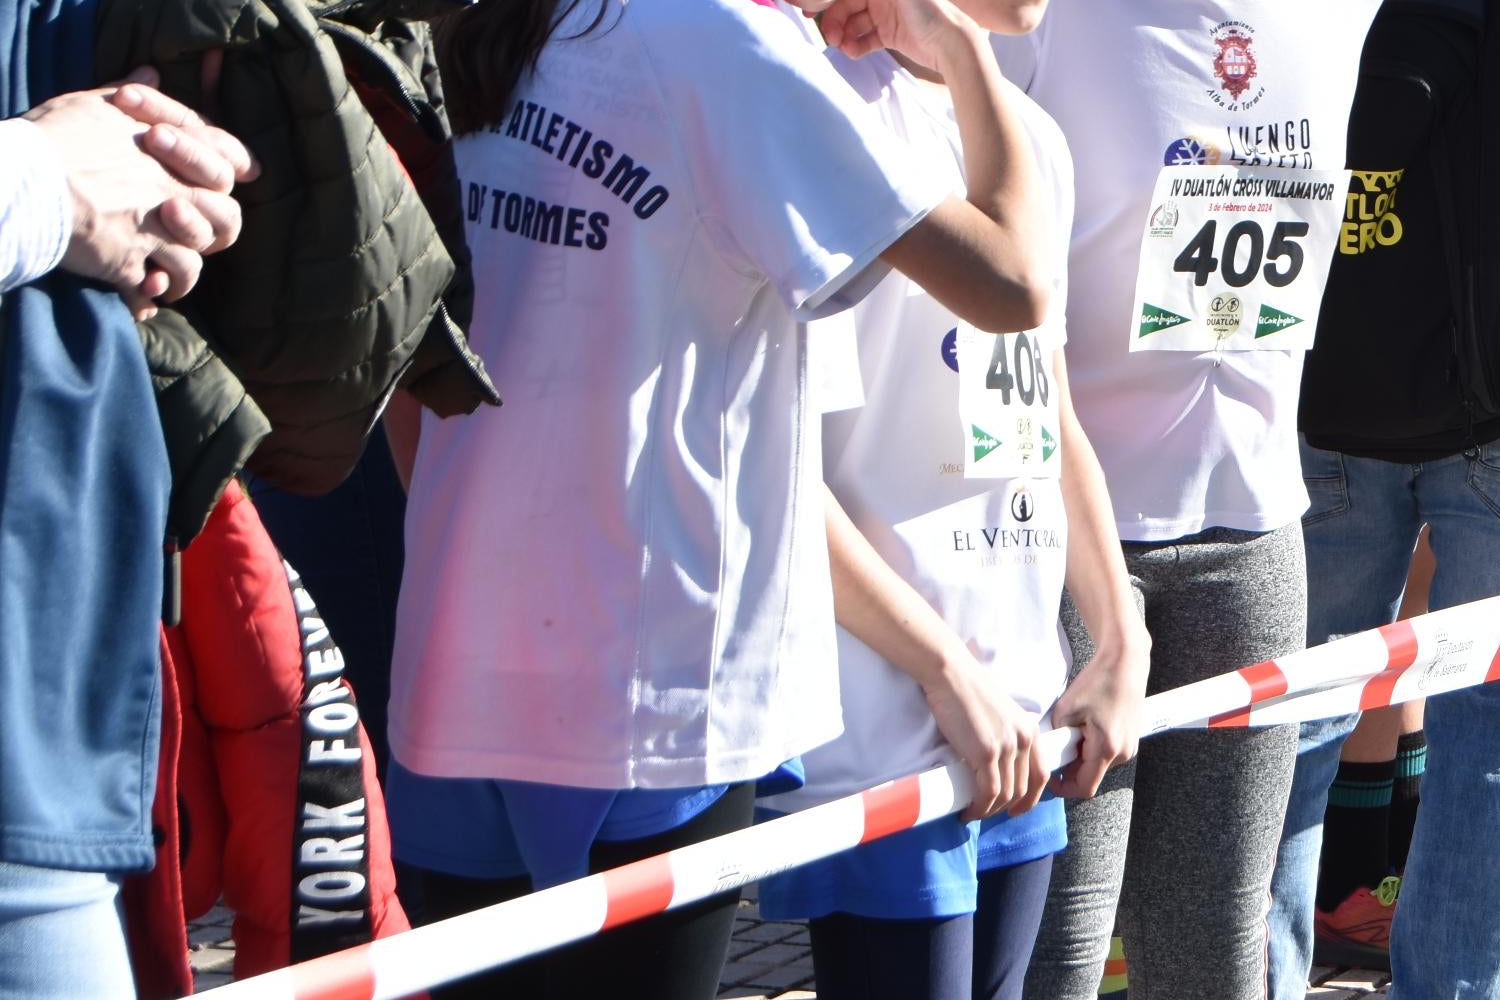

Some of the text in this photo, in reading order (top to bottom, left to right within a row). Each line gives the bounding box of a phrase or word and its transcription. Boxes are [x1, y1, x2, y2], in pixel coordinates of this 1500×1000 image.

[1208, 19, 1256, 37] Ayuntamiento
[1206, 86, 1266, 112] Alba de Tormes
[1226, 118, 1311, 161] LUENGO
[506, 100, 670, 221] ATLETISMO
[1170, 175, 1335, 201] IV DUATLÓN CROSS VILLAMAYOR
[491, 188, 610, 251] TORMES
[1208, 203, 1273, 213] 3 de Febrero de 2024
[1173, 219, 1310, 288] 405
[953, 530, 976, 551] EL
[298, 797, 366, 927] YORK
